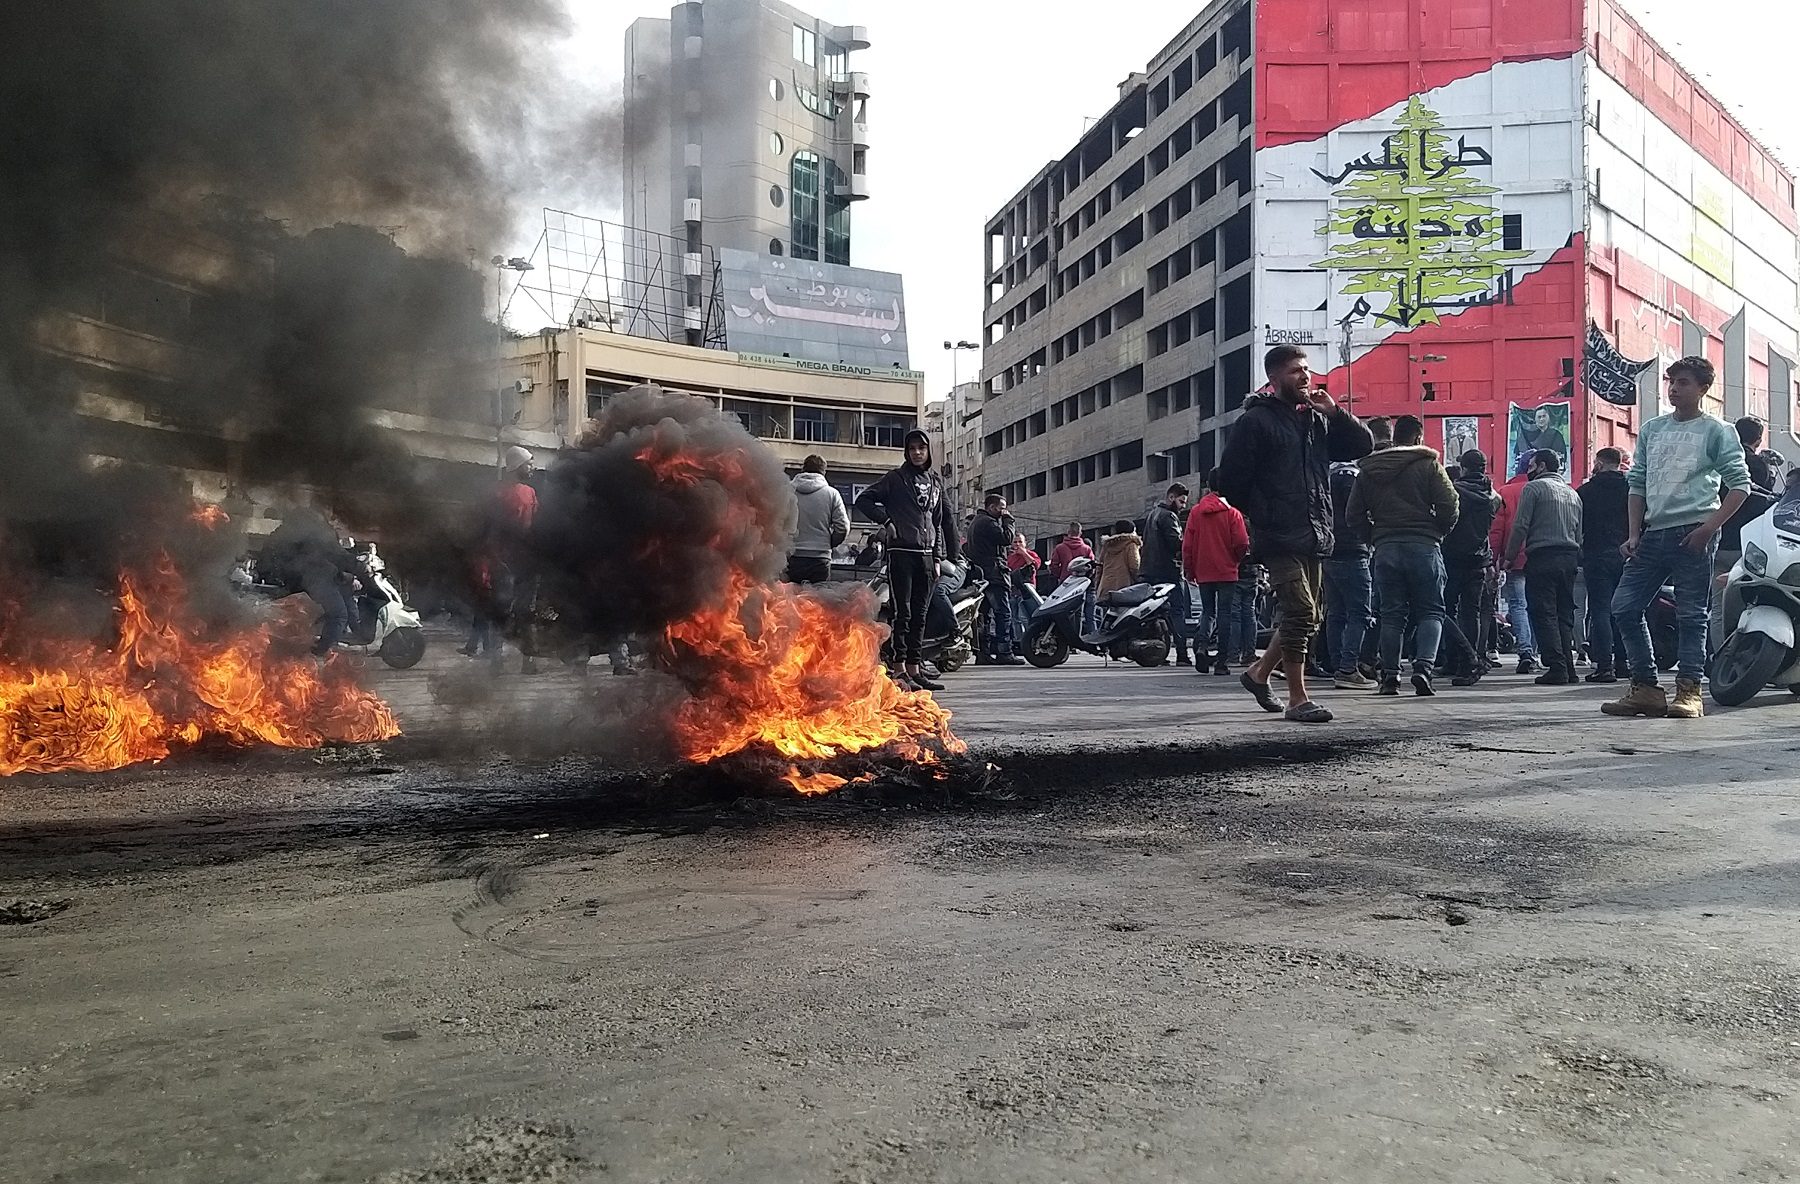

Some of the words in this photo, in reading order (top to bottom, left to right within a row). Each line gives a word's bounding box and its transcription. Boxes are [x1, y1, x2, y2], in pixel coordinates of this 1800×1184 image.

[1309, 130, 1493, 184] طرابلس
[1352, 209, 1484, 244] مدينة
[1340, 267, 1514, 328] السلام
[796, 360, 829, 371] MEGA
[831, 363, 872, 376] BRAND
